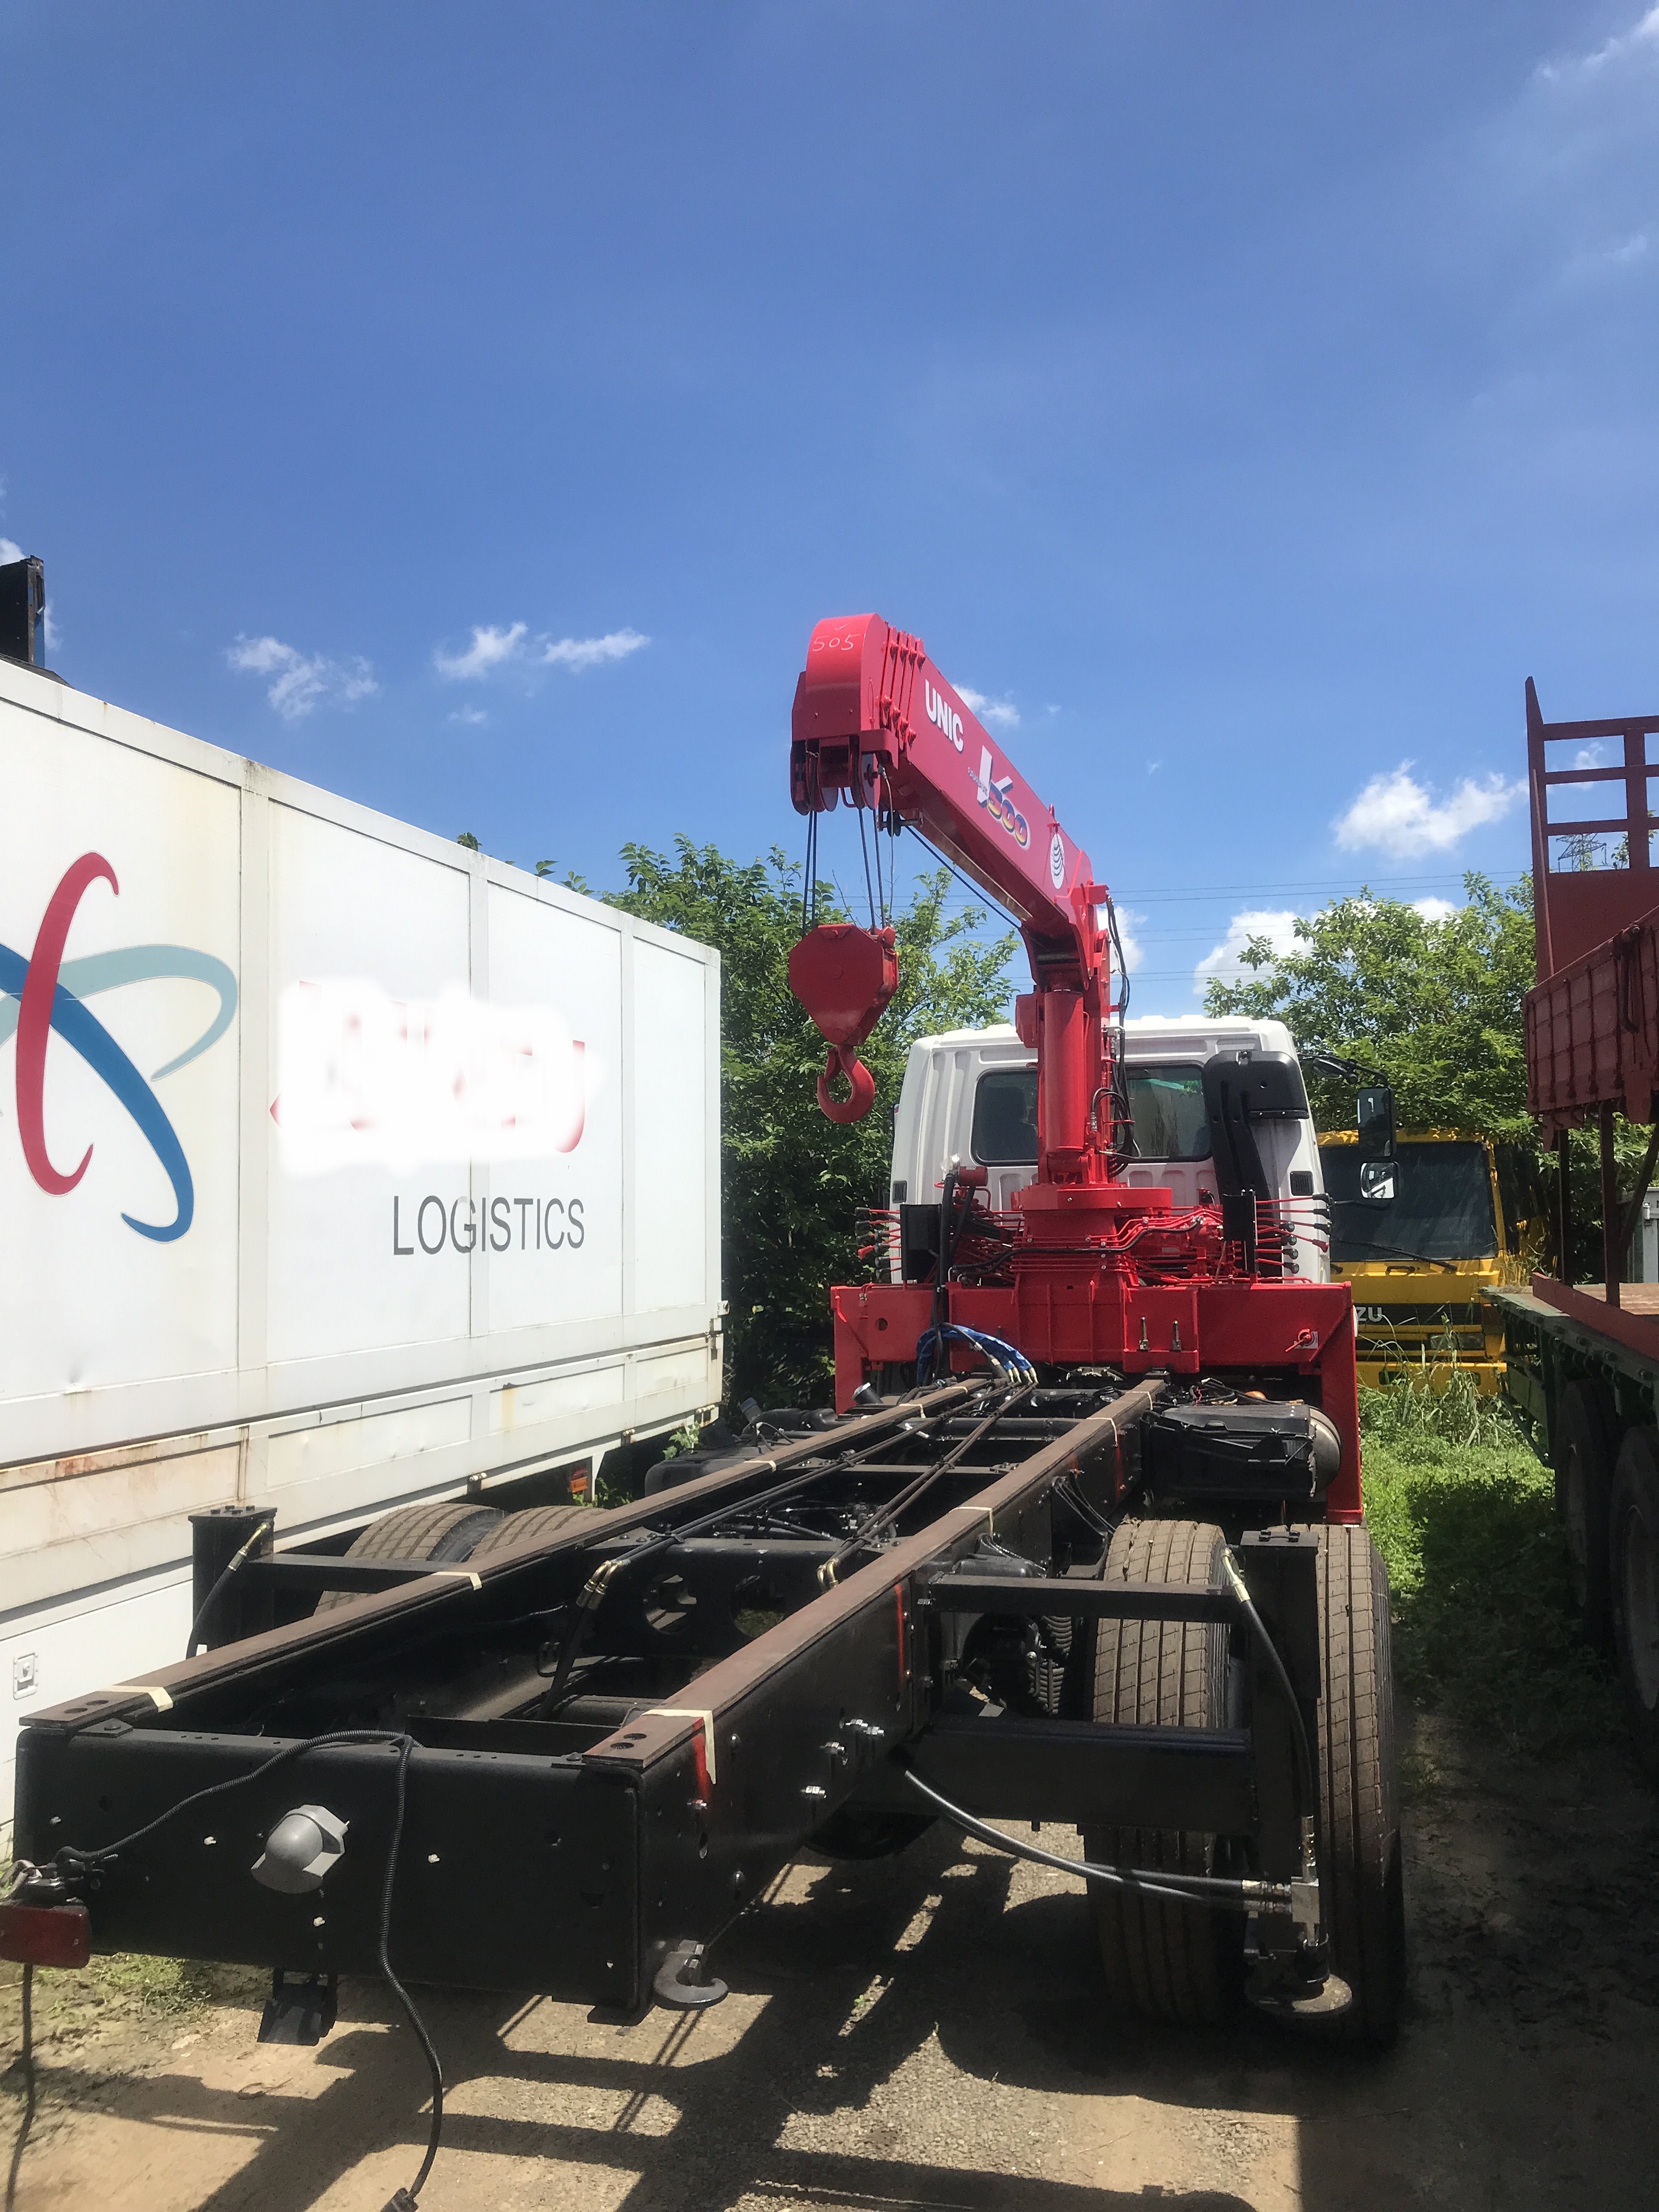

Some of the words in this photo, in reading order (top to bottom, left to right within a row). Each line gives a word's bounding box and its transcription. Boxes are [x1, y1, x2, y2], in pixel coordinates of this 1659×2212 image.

[812, 634, 860, 652] 505
[925, 679, 963, 752] UNIC
[393, 1195, 585, 1256] LOGISTICS
